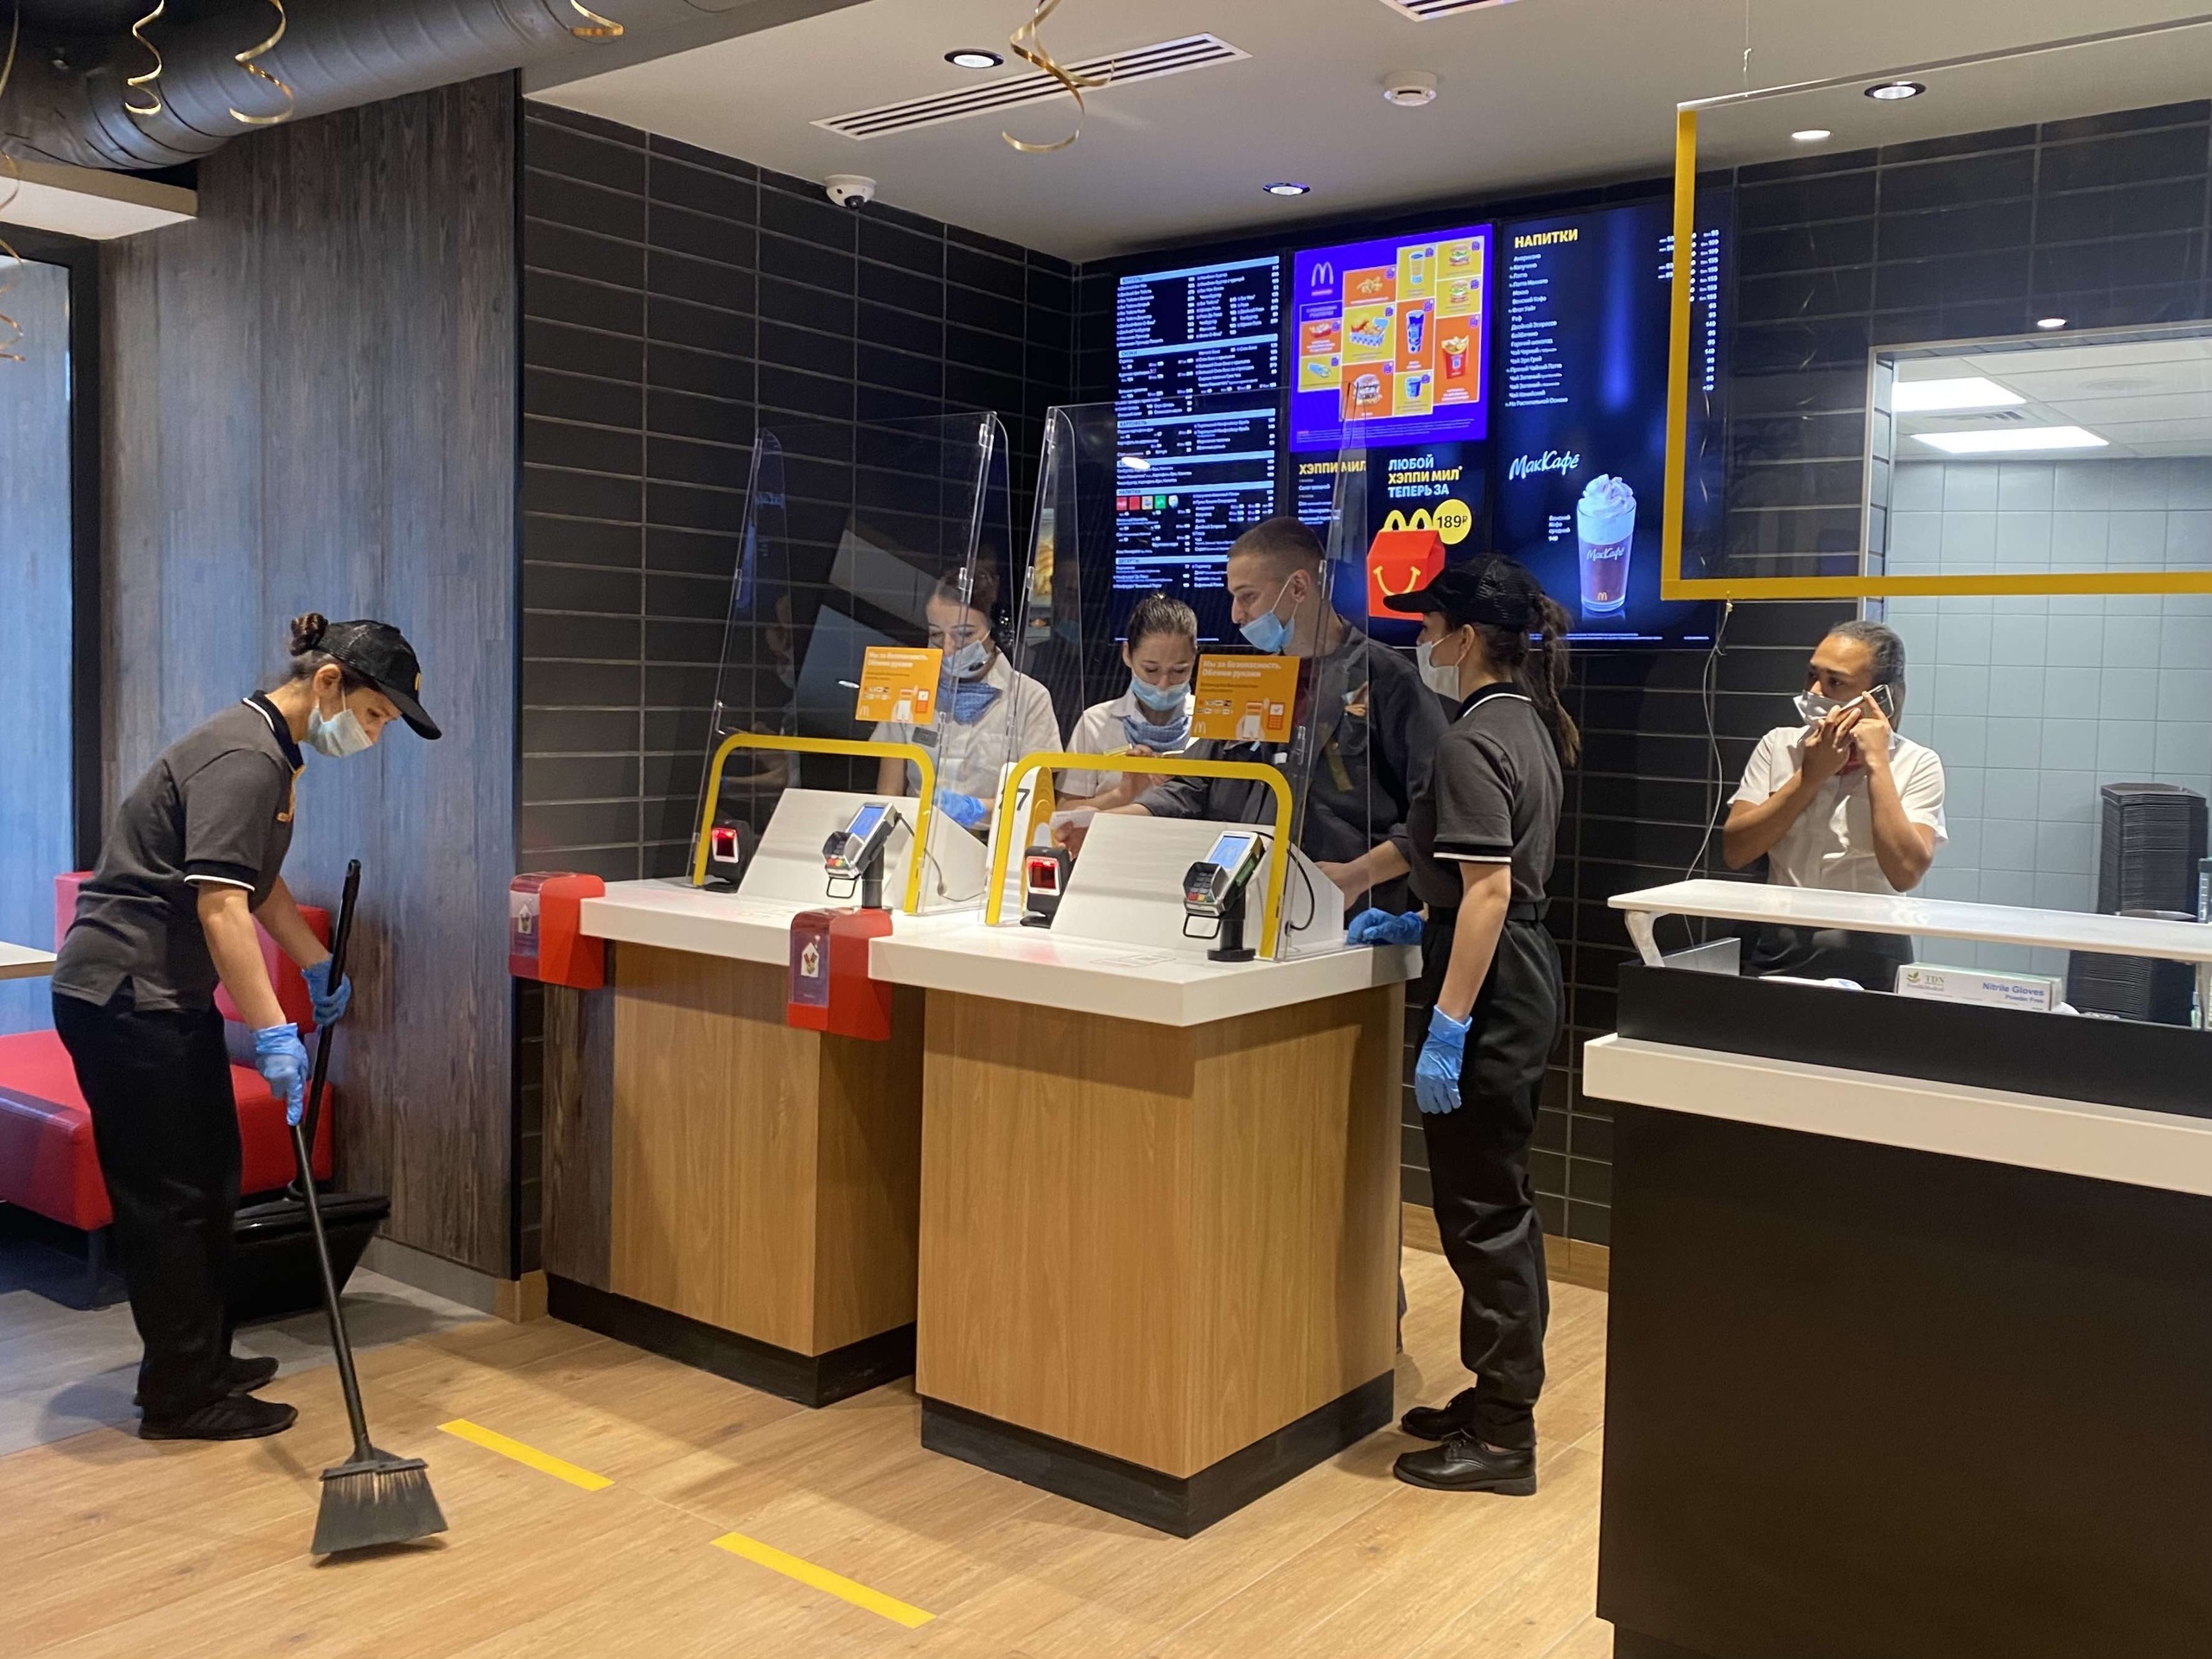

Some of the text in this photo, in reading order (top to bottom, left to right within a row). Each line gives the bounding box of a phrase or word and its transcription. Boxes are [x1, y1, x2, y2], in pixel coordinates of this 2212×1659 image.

[1514, 228, 1579, 249] НАПИТКИ
[1299, 461, 1338, 475] ХЭППИ
[1388, 454, 1434, 471] ЛЮБОЙ
[1388, 471, 1430, 485] ХЭППИ
[1388, 483, 1450, 499] ТЕПЕРЬ ЗА
[1981, 981, 2044, 997] Nitrile Gloves
